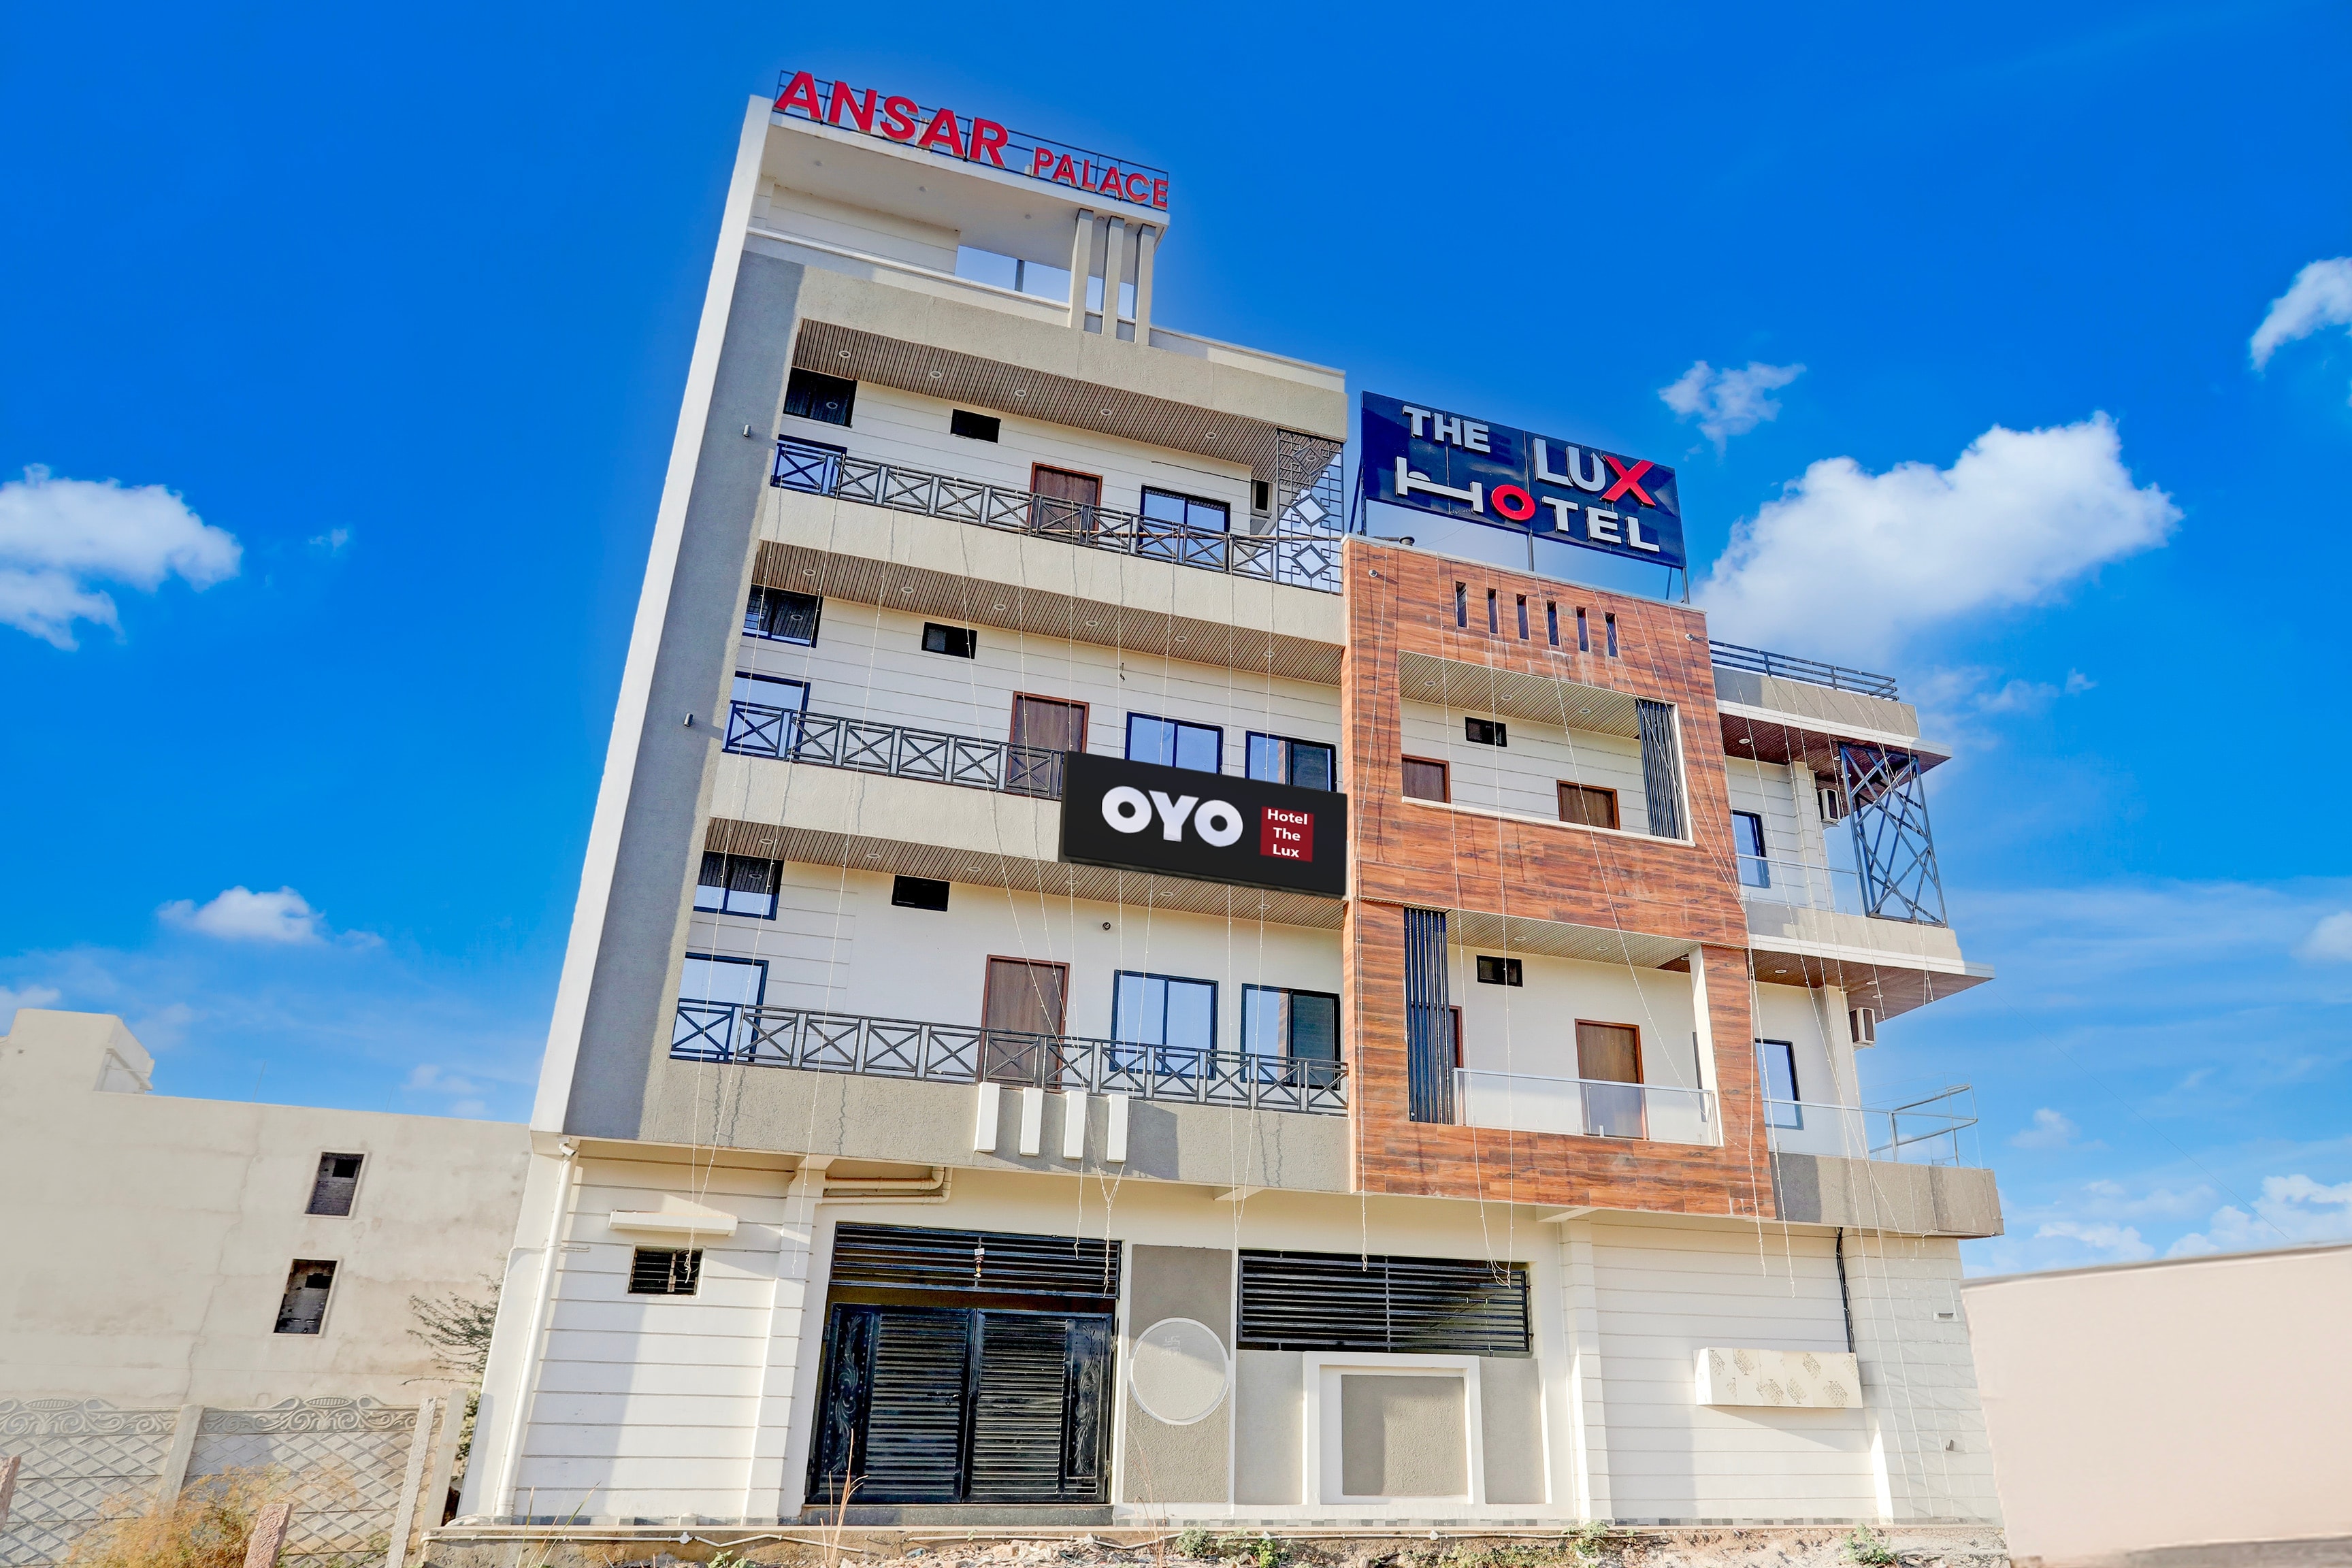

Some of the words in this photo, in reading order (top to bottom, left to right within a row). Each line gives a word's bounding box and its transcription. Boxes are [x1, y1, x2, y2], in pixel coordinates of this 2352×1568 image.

[773, 71, 1009, 169] ANSAR
[1033, 146, 1169, 210] PALACE
[1402, 405, 1490, 453] THE
[1533, 438, 1656, 506] LUX
[1395, 456, 1660, 552] HOTEL
[1102, 786, 1243, 847] OYO
[1267, 809, 1307, 825] Hotel
[1273, 827, 1301, 841] The
[1273, 844, 1300, 858] Lux
